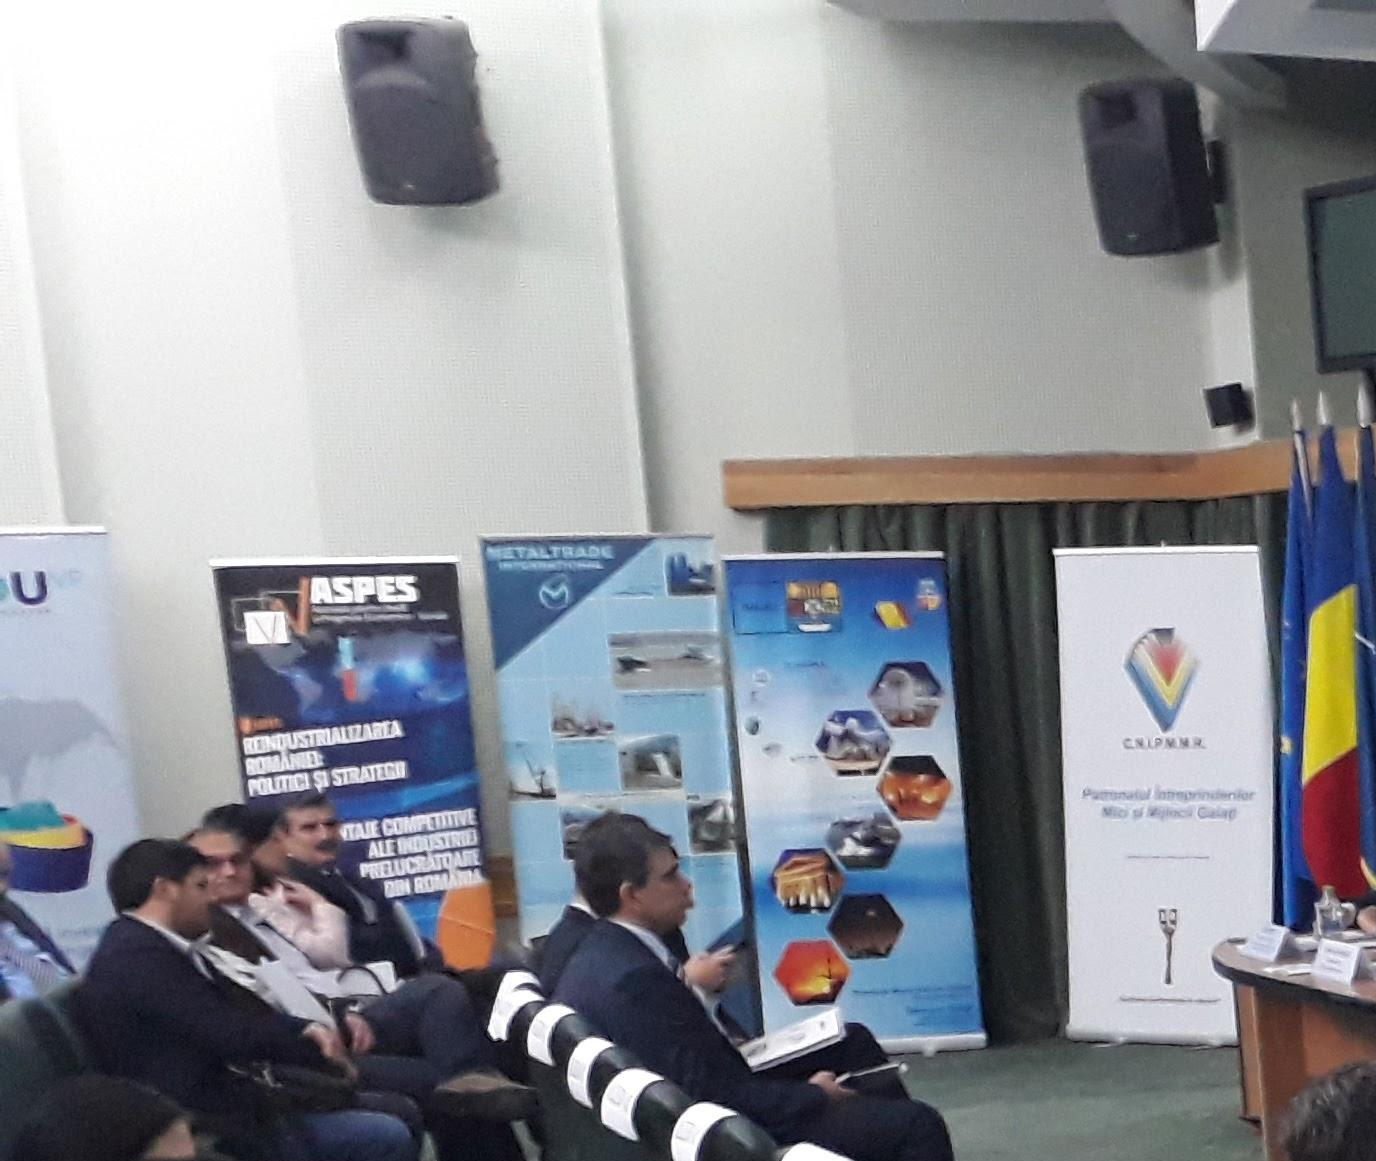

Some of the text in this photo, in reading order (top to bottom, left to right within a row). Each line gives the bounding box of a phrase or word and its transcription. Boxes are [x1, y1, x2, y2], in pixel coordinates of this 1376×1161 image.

[311, 576, 418, 603] ASPES
[382, 808, 477, 836] COMPETITIVE
[368, 839, 397, 859] ALE
